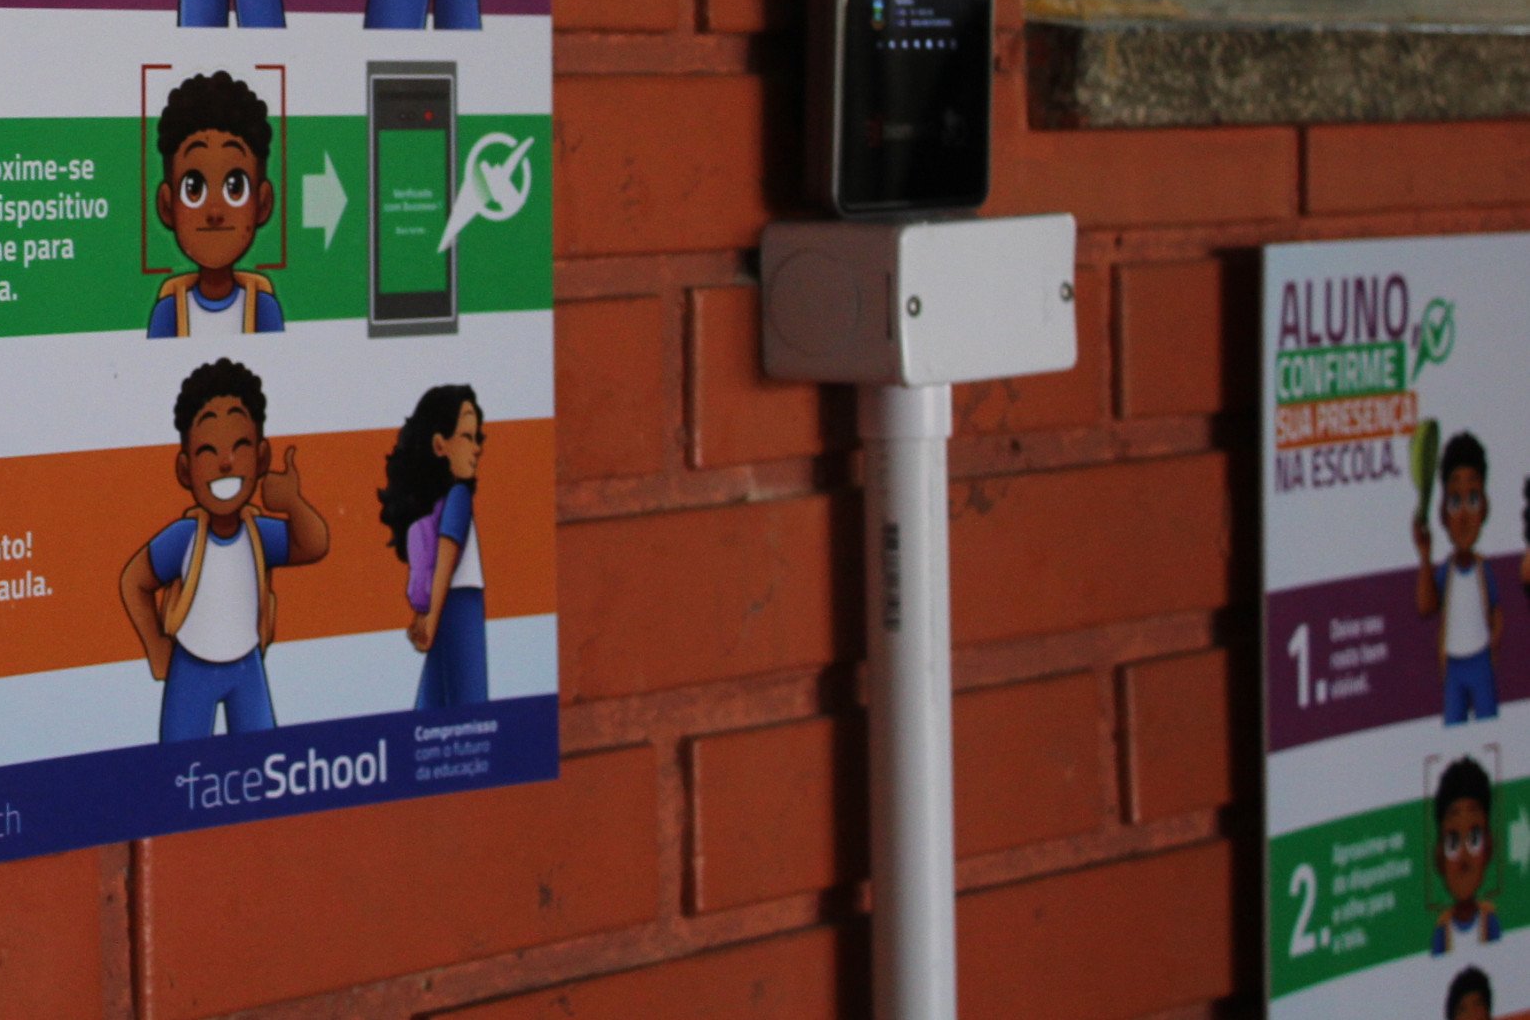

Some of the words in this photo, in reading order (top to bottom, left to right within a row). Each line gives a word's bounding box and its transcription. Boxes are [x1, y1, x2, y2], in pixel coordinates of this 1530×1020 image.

[23, 238, 75, 268] para
[1279, 272, 1420, 350] ALUNO,
[1278, 348, 1397, 399] CONFIRME
[1288, 623, 1328, 709] 1.
[414, 720, 498, 742] Compromisso
[175, 739, 387, 810] faceSchool
[1290, 863, 1330, 958] 2.
